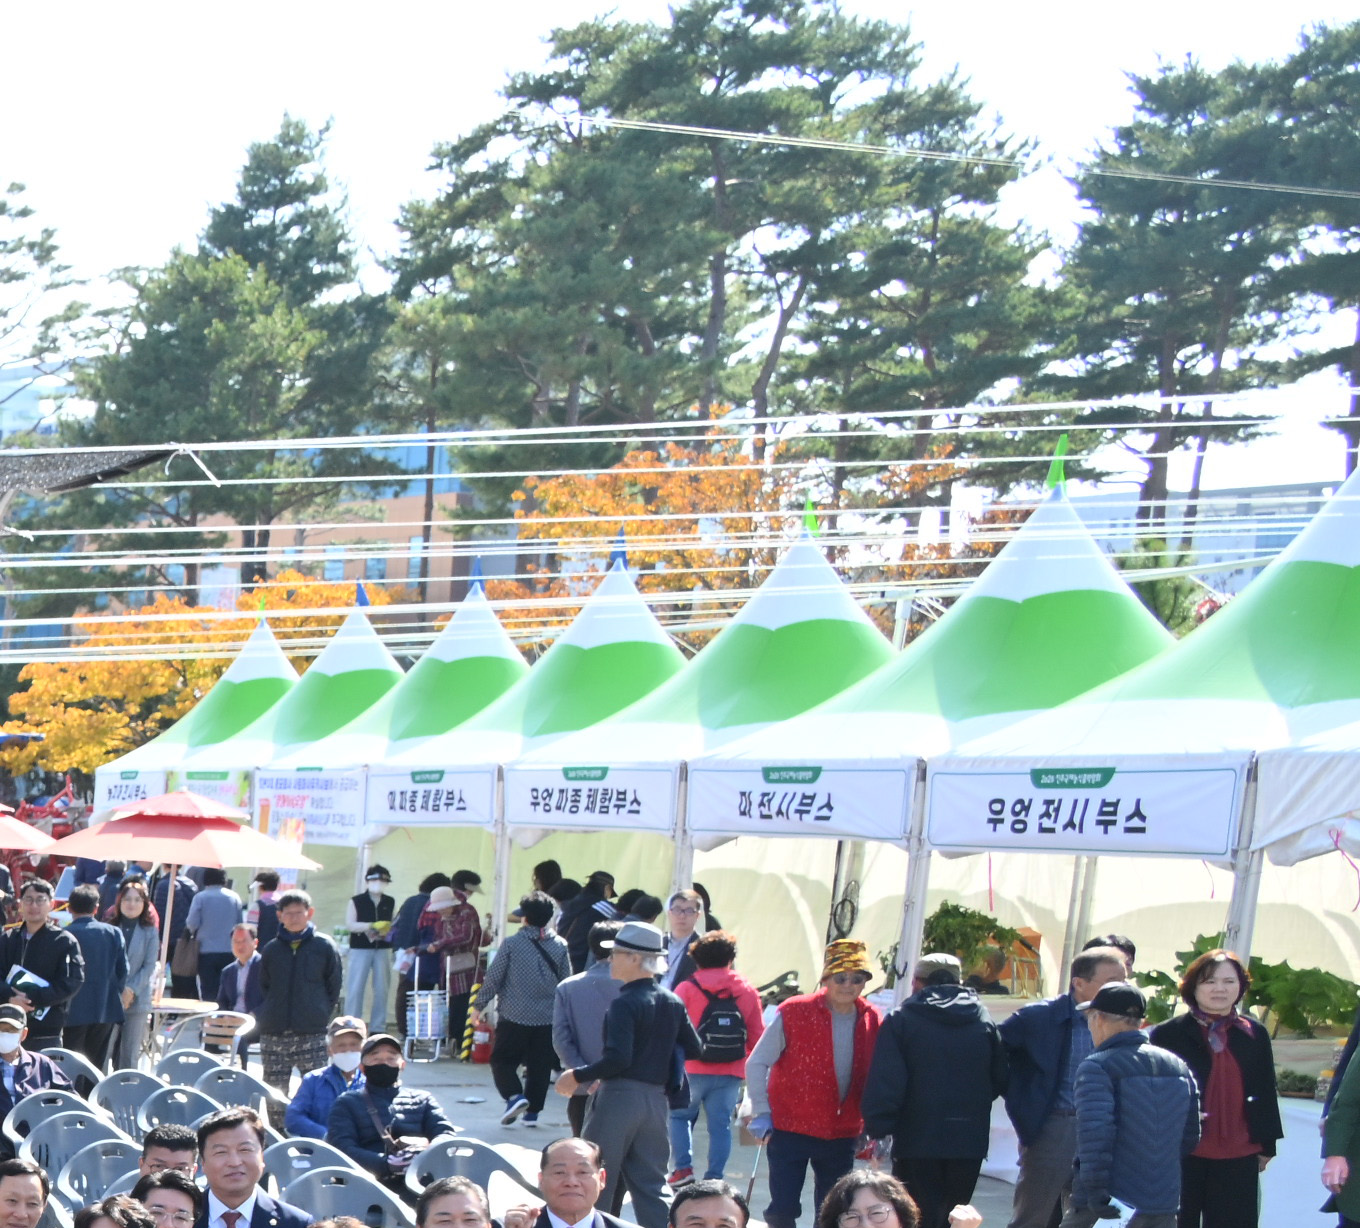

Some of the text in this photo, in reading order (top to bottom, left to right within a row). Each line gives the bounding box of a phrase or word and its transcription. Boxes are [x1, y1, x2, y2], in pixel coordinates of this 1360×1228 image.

[387, 790, 396, 811] 마
[399, 790, 418, 812] 파종
[530, 787, 554, 814] 우엉
[555, 788, 582, 814] 파종
[738, 790, 753, 818] 마
[986, 797, 1033, 834] 우엉
